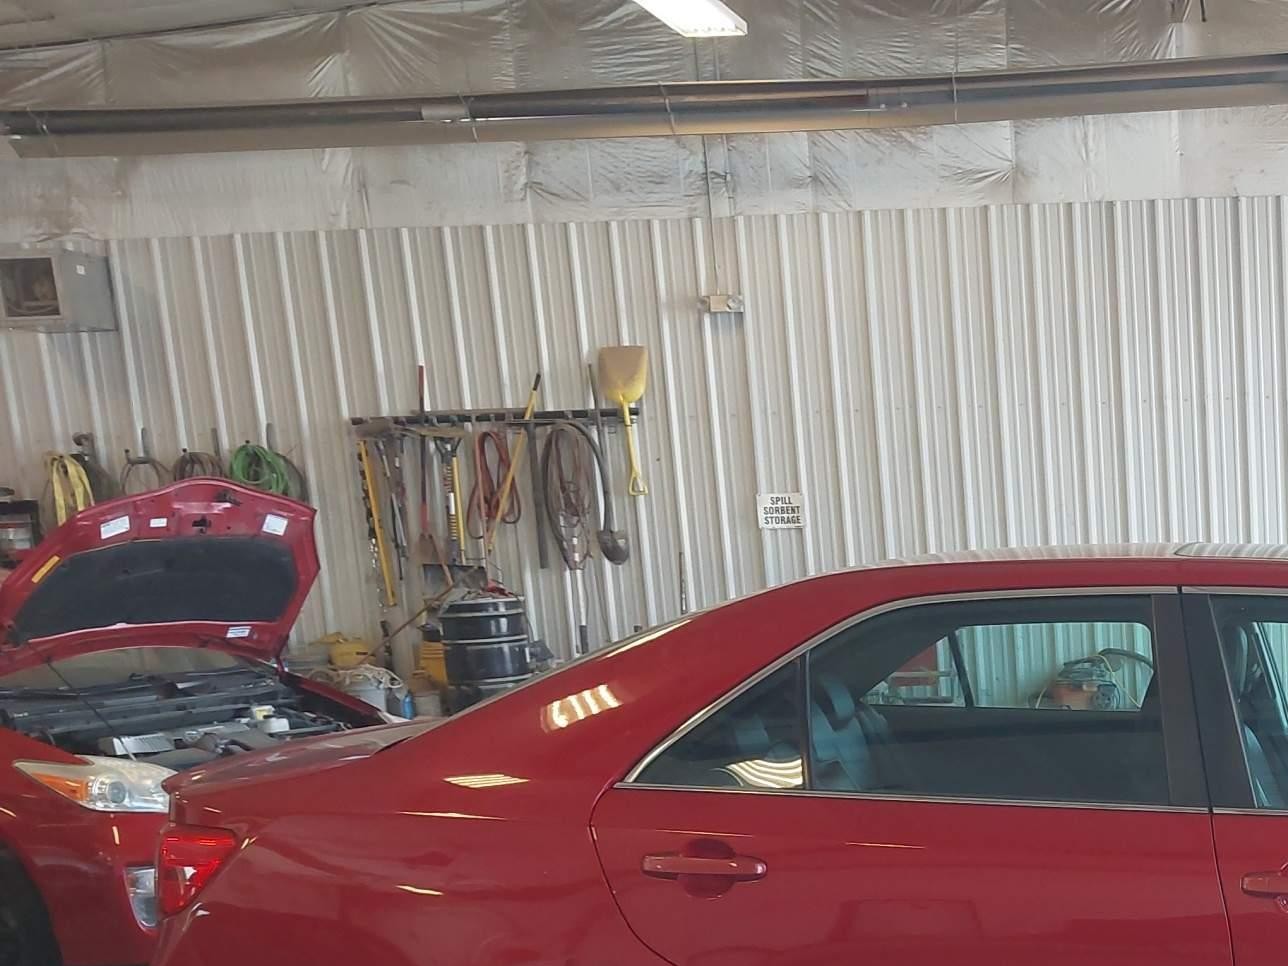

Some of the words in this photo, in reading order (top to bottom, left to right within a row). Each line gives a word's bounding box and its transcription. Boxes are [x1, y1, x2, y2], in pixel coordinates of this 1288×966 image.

[770, 496, 793, 505] SPILL
[763, 506, 801, 515] SORBENT
[764, 516, 802, 525] STORAGE
